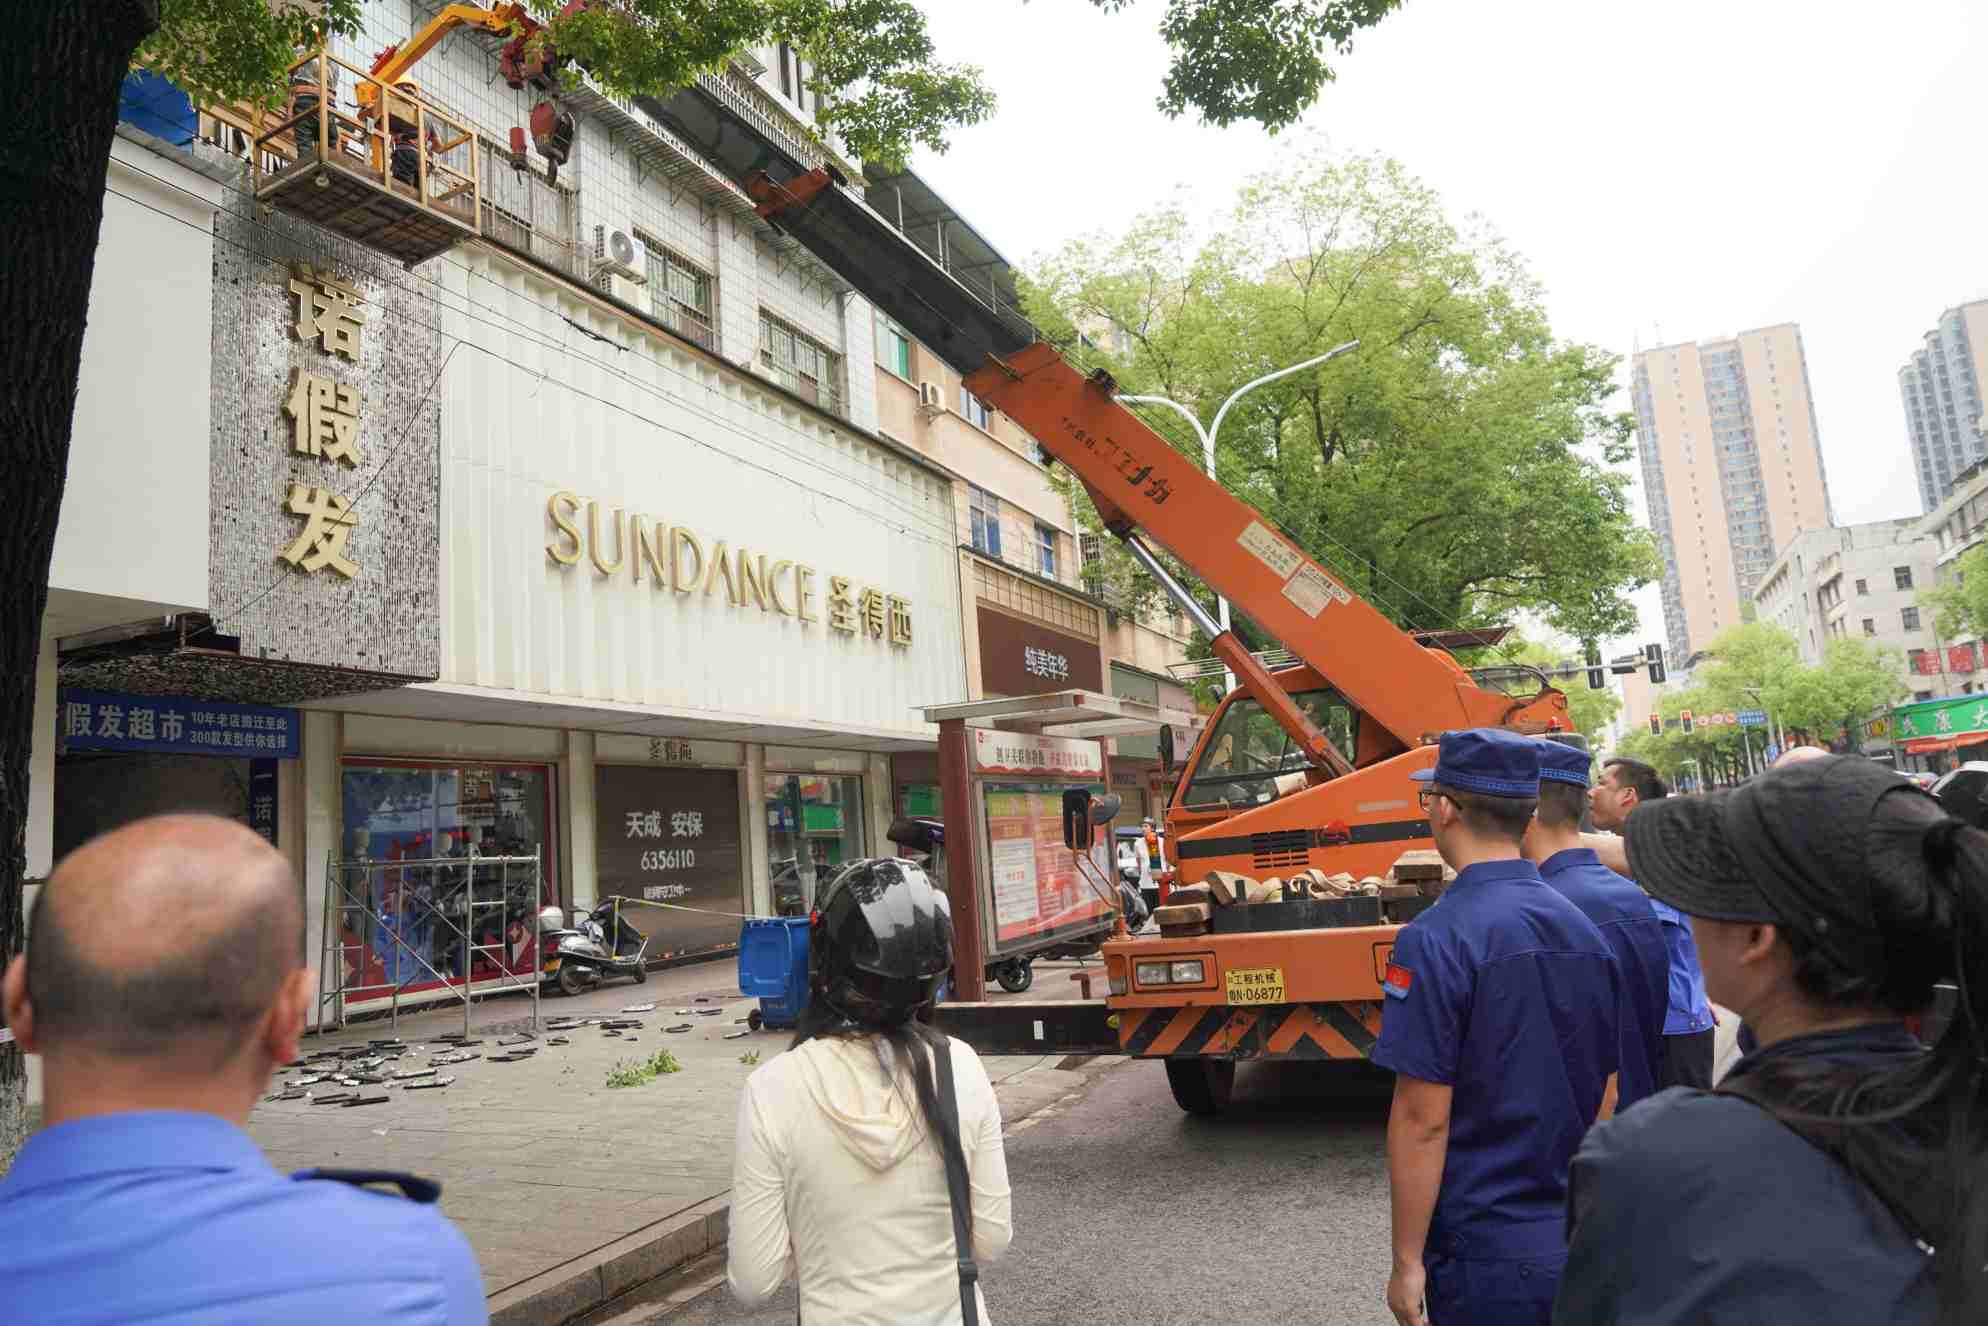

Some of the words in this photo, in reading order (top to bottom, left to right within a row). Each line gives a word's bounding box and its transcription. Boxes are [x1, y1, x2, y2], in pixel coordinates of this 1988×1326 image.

[545, 491, 816, 624] SUNDANCE
[829, 575, 913, 648] 圣得西
[65, 702, 185, 742] 假发超市
[625, 810, 662, 838] 天成
[671, 810, 704, 837] 安保
[640, 849, 695, 871] 6356110
